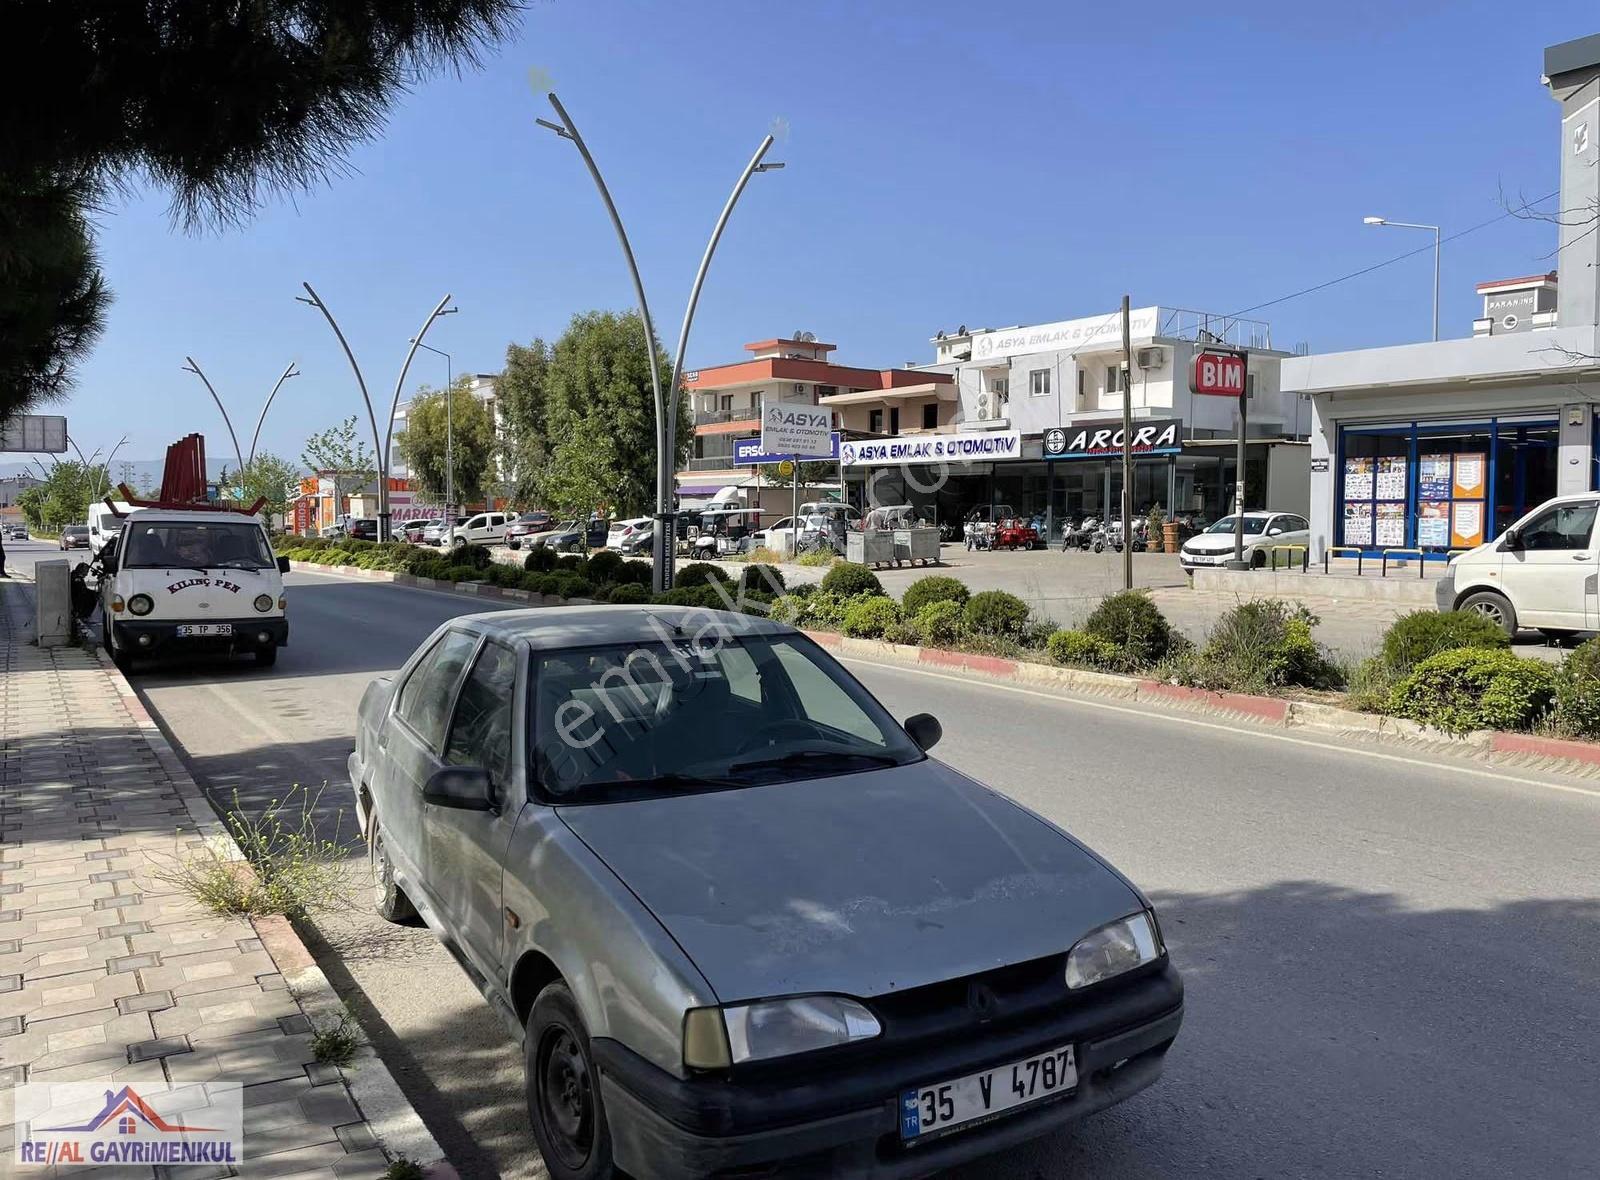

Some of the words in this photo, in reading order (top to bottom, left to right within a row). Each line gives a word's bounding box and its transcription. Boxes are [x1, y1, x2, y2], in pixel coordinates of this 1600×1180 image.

[996, 336, 1026, 350] ASYA
[1029, 329, 1070, 346] EMLAK
[1072, 328, 1080, 338] &
[783, 412, 828, 428] ASYA
[765, 425, 788, 434] EMLAK
[738, 446, 770, 458] ERSO
[859, 444, 887, 459] ASYA
[890, 442, 932, 460] EMLAK
[935, 441, 945, 455] &
[167, 579, 211, 595] KILINÇ
[214, 579, 241, 594] PEN
[182, 624, 194, 636] 35
[198, 624, 210, 636] TP
[215, 624, 232, 636] 356
[920, 1085, 954, 1127] 35
[979, 1074, 993, 1110] V
[1012, 1050, 1070, 1099] 4787
[904, 1115, 918, 1128] TR
